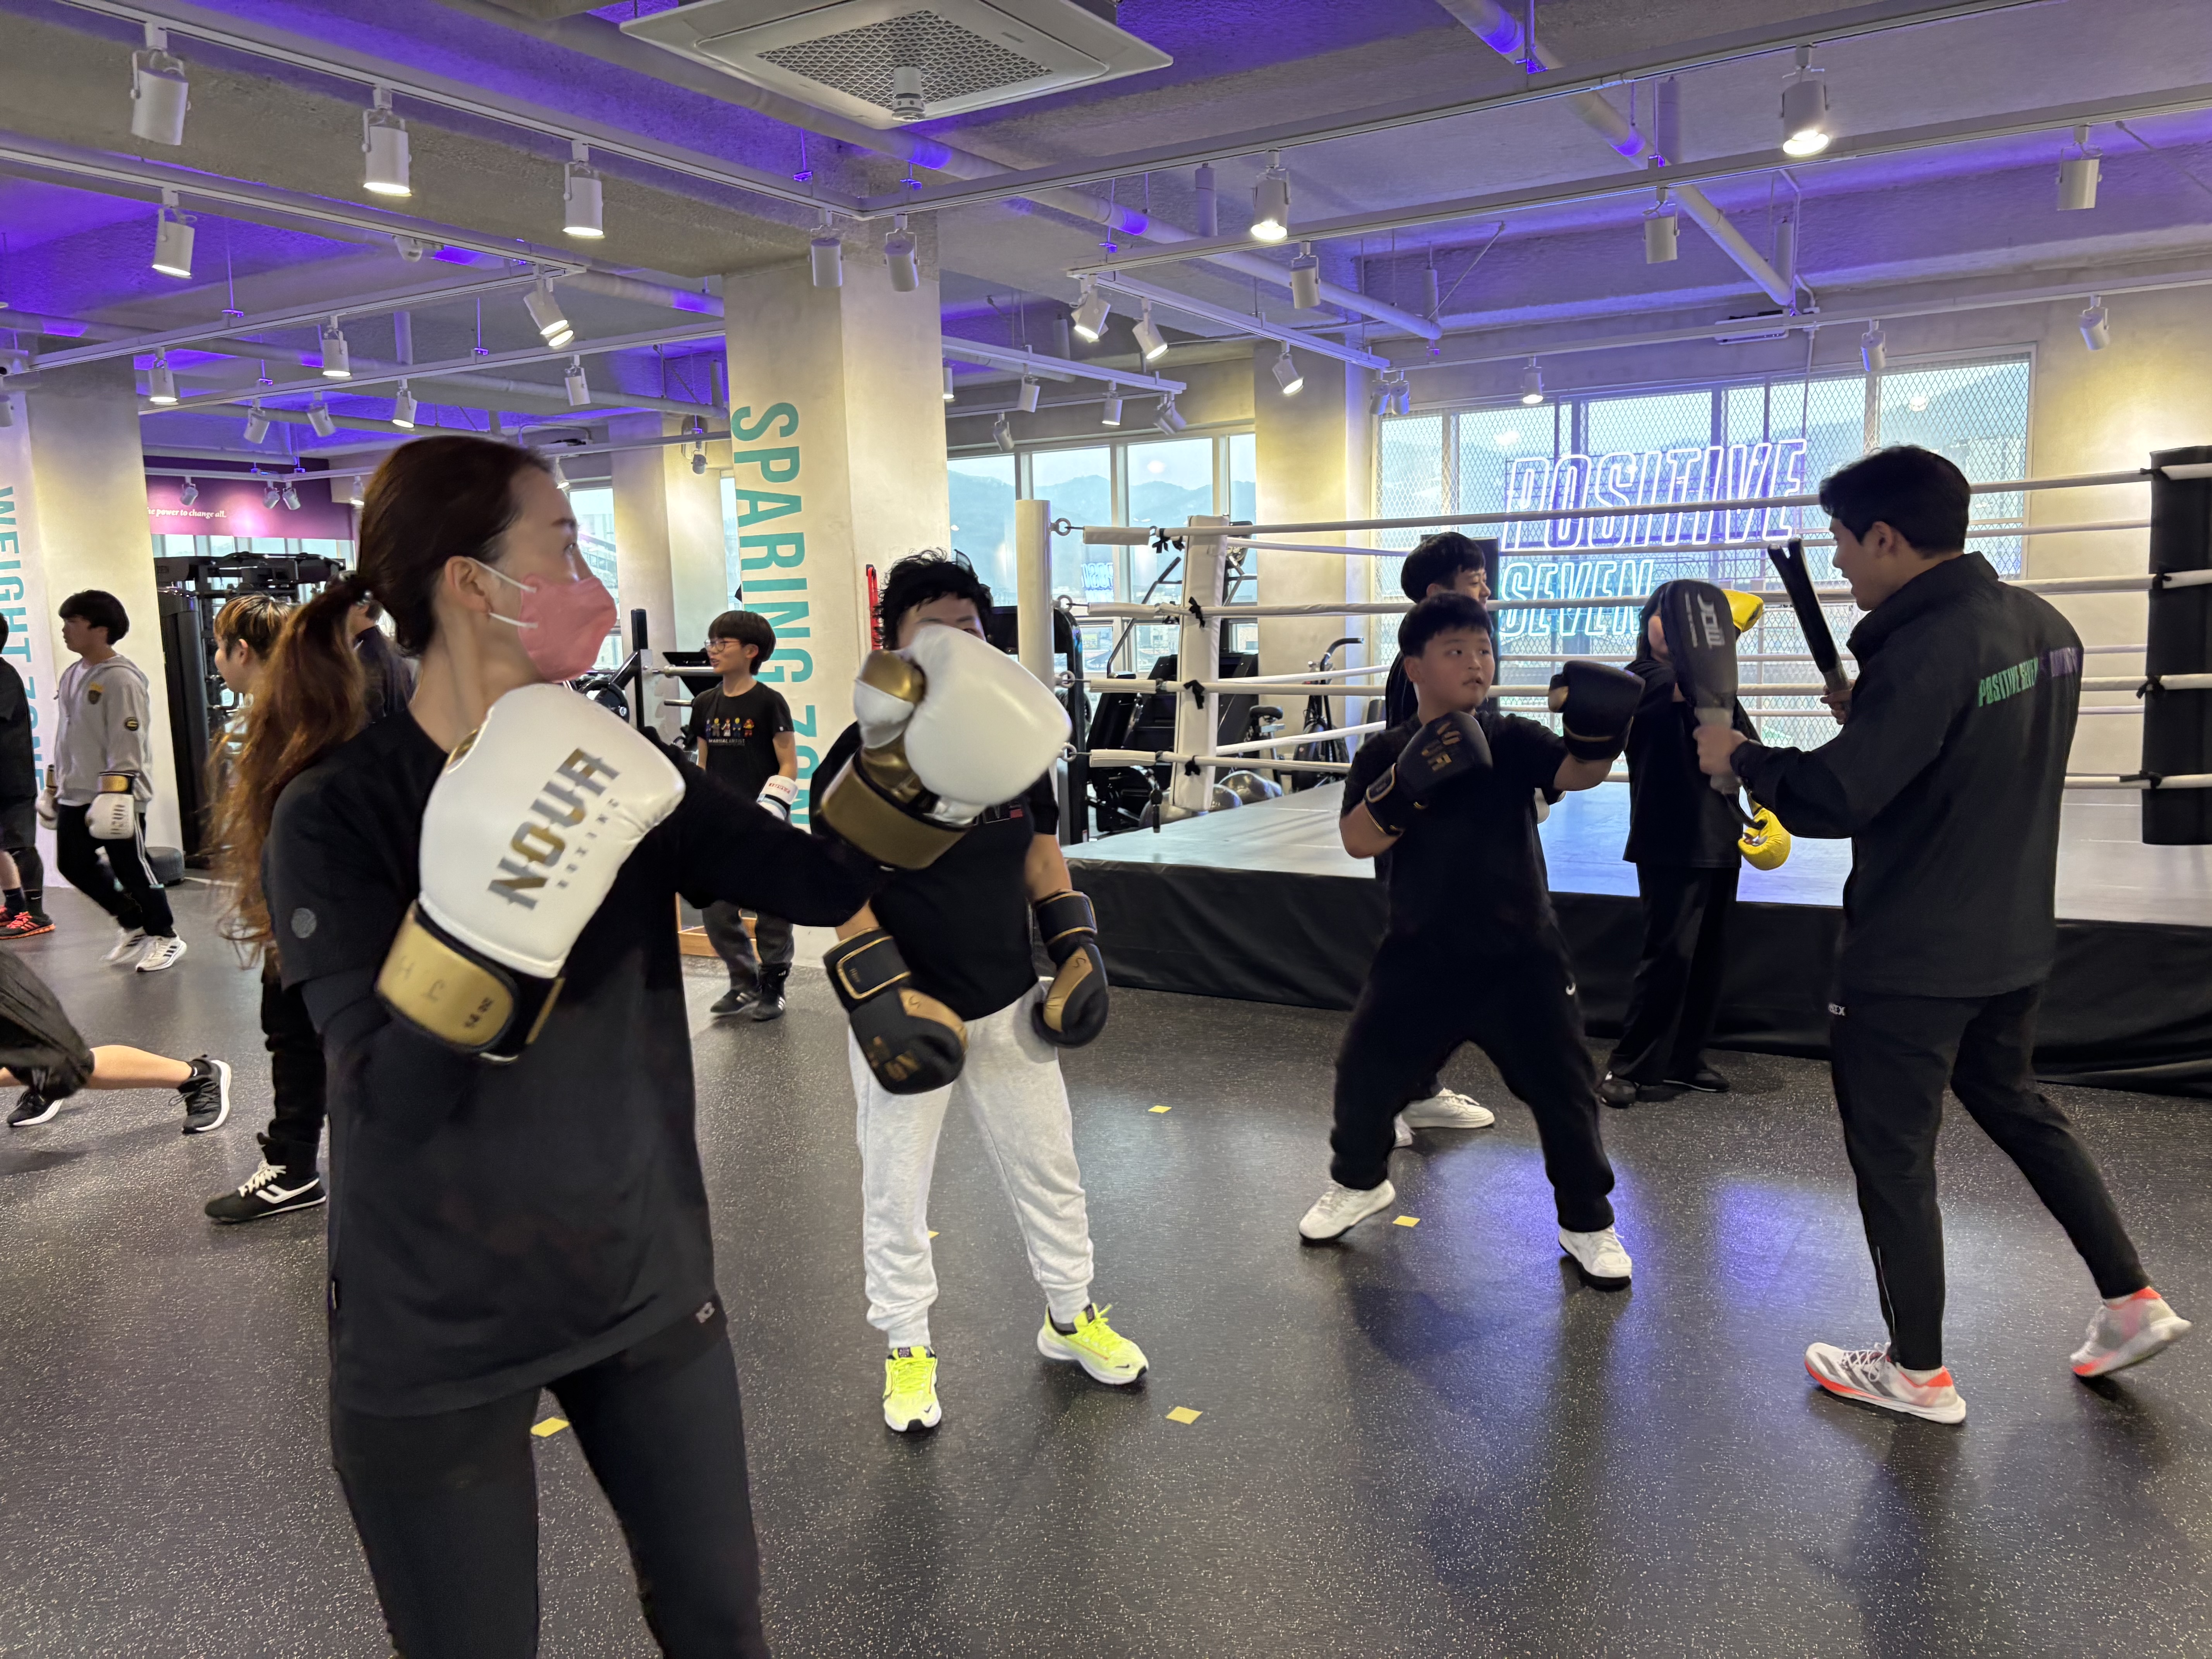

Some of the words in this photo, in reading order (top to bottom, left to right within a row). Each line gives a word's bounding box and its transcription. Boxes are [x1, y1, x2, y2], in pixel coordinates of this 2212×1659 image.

[156, 509, 179, 517] power
[189, 509, 213, 519] change
[1500, 438, 1807, 552] POSITIVE
[731, 402, 814, 682] SPARING
[1499, 559, 1654, 637] SEVEN
[1978, 665, 2021, 707] POSITIVE
